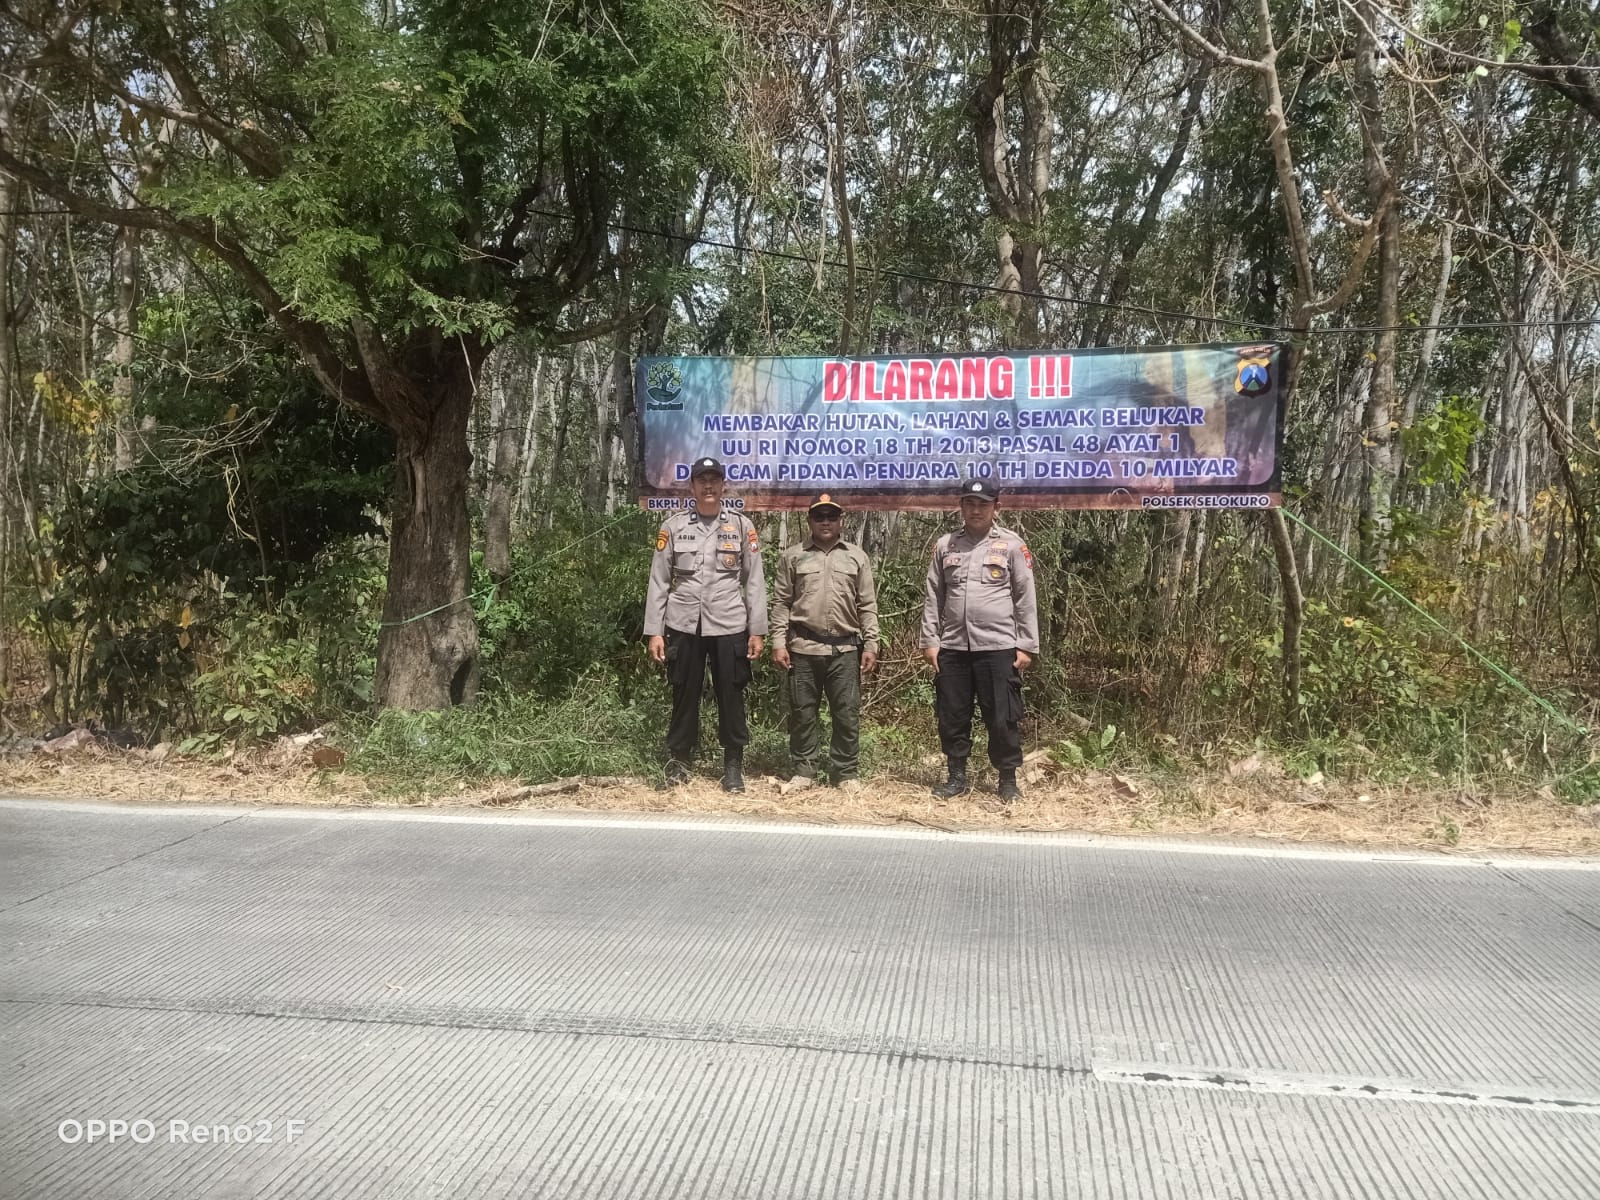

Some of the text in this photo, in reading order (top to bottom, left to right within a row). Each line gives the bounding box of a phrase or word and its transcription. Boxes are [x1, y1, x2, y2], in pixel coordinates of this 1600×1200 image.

[823, 356, 1073, 402] DILARANG !!!
[703, 406, 1205, 432] MEMBAKAR HUTAN, LAHAN & SEMAK BELUKAR
[721, 433, 1180, 456] UU RI NOMOR 18 TH 2013 PASAL 48 AYAT 1
[676, 458, 1237, 481] DCAM PIDANA PENJARA 10 TH DENDA 10 MILYAR
[647, 498, 680, 510] BKPH
[1141, 495, 1270, 508] POLSEK SELOKURO
